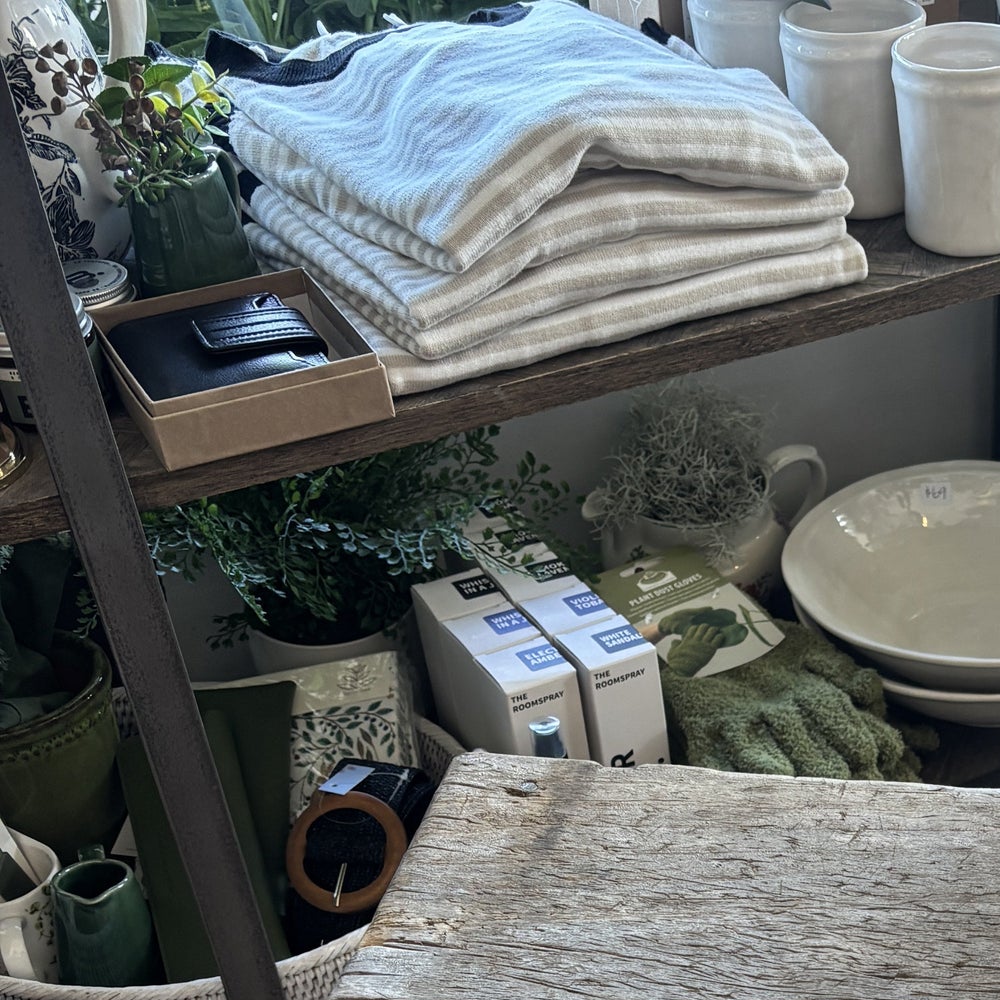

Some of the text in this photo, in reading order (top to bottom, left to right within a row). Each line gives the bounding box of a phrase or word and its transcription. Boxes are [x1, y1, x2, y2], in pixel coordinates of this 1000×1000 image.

[464, 586, 478, 595] IN
[628, 593, 655, 607] PLANT
[673, 573, 703, 588] GLOVES
[496, 621, 511, 629] IN
[599, 629, 632, 642] WHITE
[594, 670, 611, 681] THE
[595, 668, 646, 690] ROOMSPRAY
[510, 693, 528, 704] THE
[512, 690, 565, 713] ROOMSPRAY
